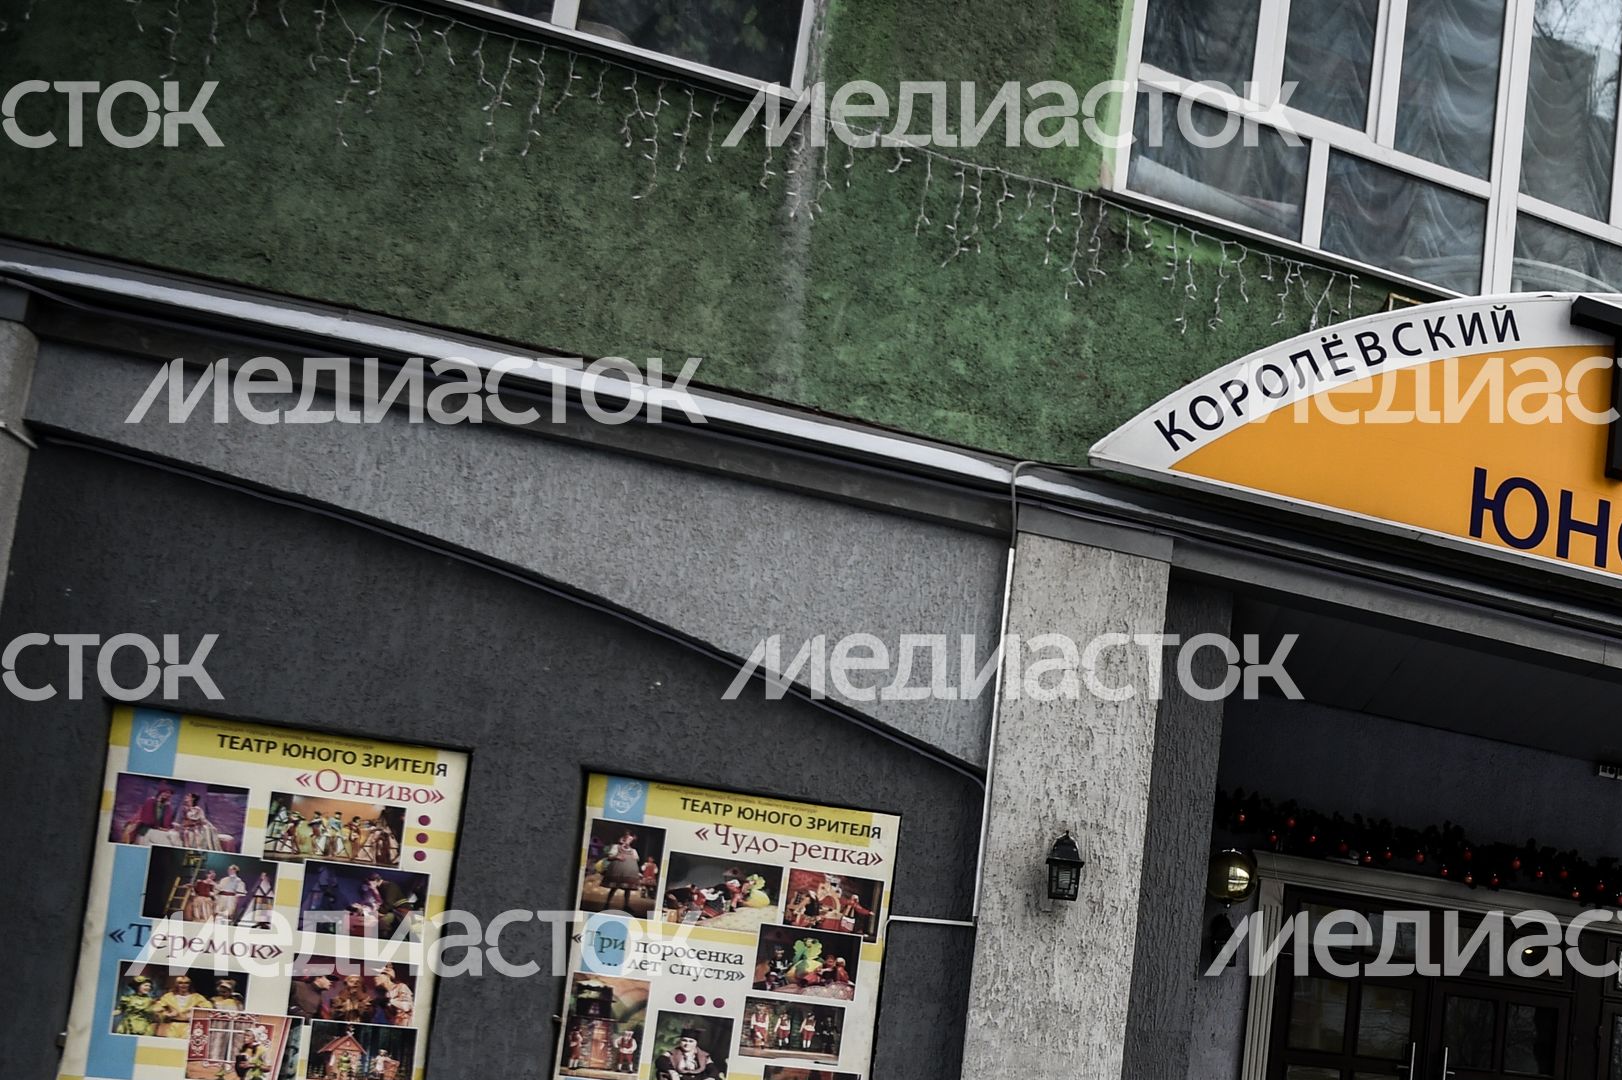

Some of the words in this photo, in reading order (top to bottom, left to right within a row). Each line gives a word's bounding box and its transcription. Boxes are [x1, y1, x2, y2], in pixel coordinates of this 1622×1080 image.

[1154, 304, 1520, 452] КОРОЛЁВСКИЙ
[217, 734, 277, 754] ТЕАТР
[282, 743, 357, 767] ЮНОГО
[361, 753, 447, 777] ЗРИТЕЛЯ
[296, 769, 445, 804] «Огниво»
[680, 798, 733, 817] ТЕАТР
[737, 807, 802, 828] ЮНОГО
[807, 816, 881, 839] ЗРИТЕЛЯ
[109, 923, 283, 959] «Теремок»
[636, 941, 743, 965] поросенка
[627, 958, 661, 972] лет
[669, 964, 745, 981] спустя»
